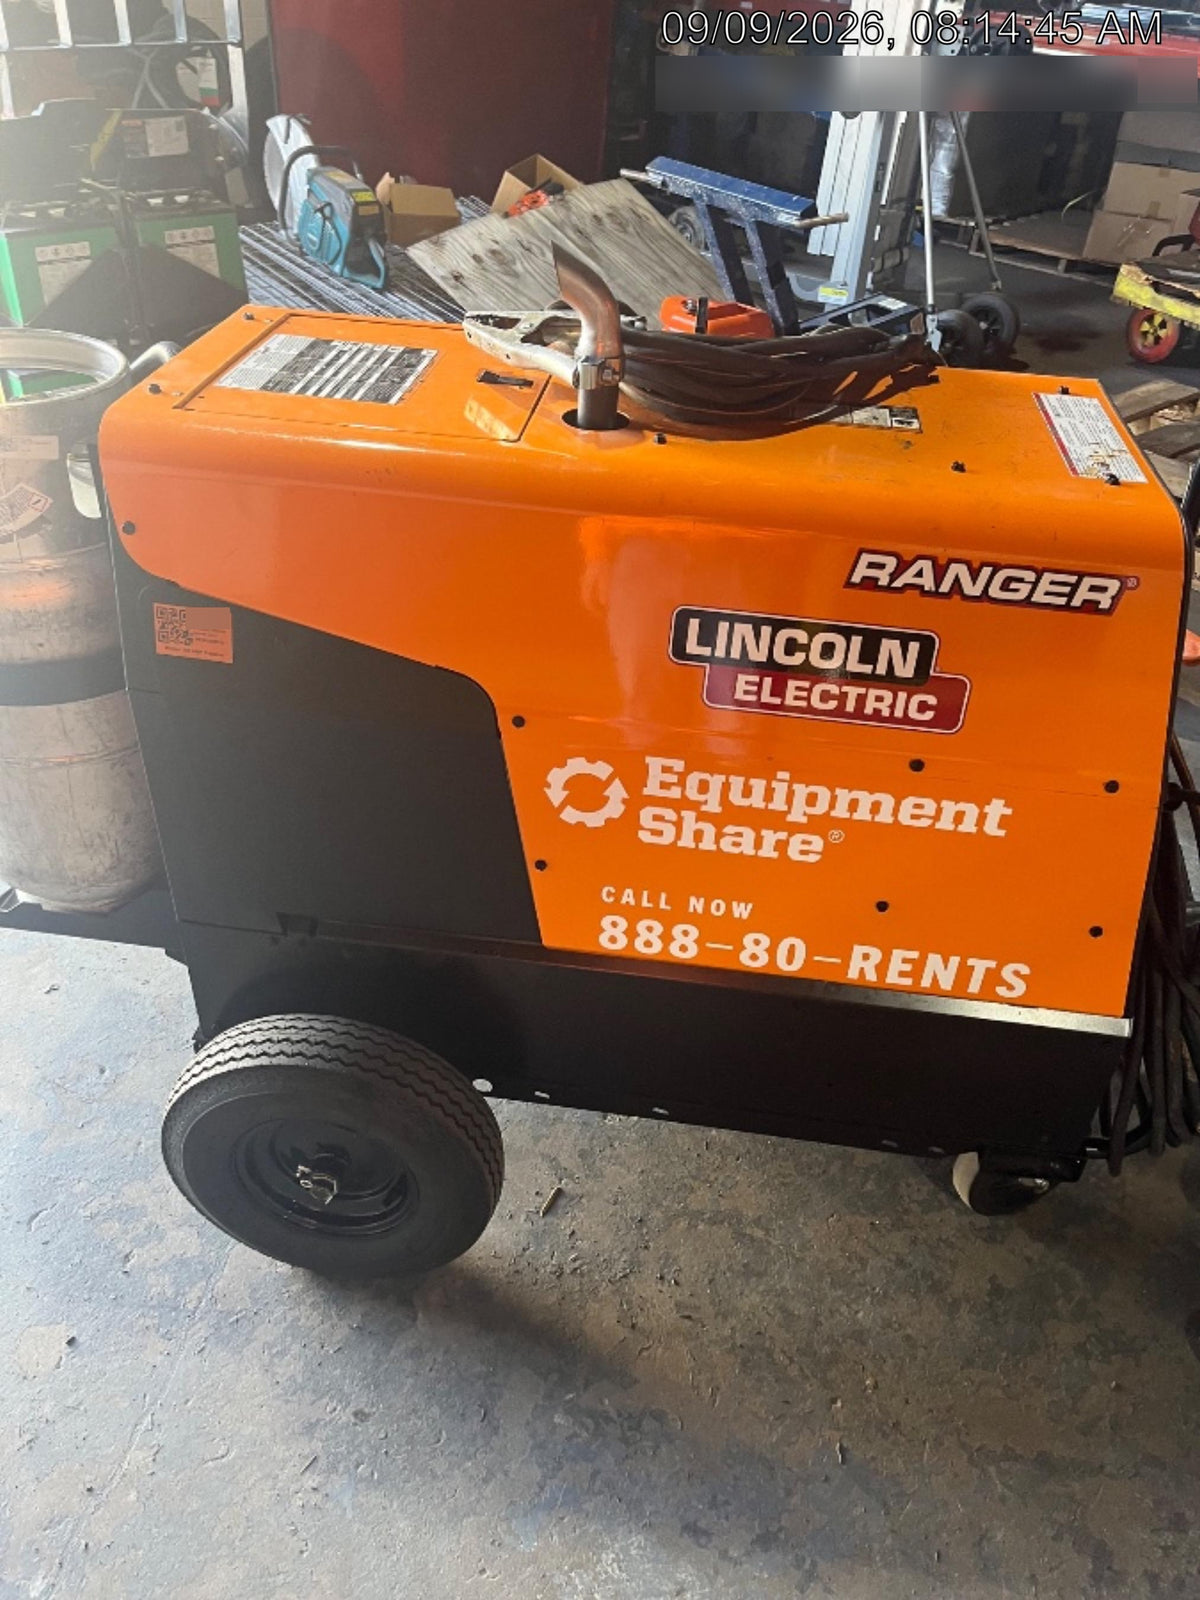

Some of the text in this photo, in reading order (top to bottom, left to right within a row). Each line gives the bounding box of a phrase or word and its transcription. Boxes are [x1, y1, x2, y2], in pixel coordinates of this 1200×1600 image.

[685, 617, 921, 678] LINCOLN
[734, 675, 937, 721] ELECTRIC
[643, 756, 1012, 836] Equipment
[601, 885, 754, 920] CALL NOW
